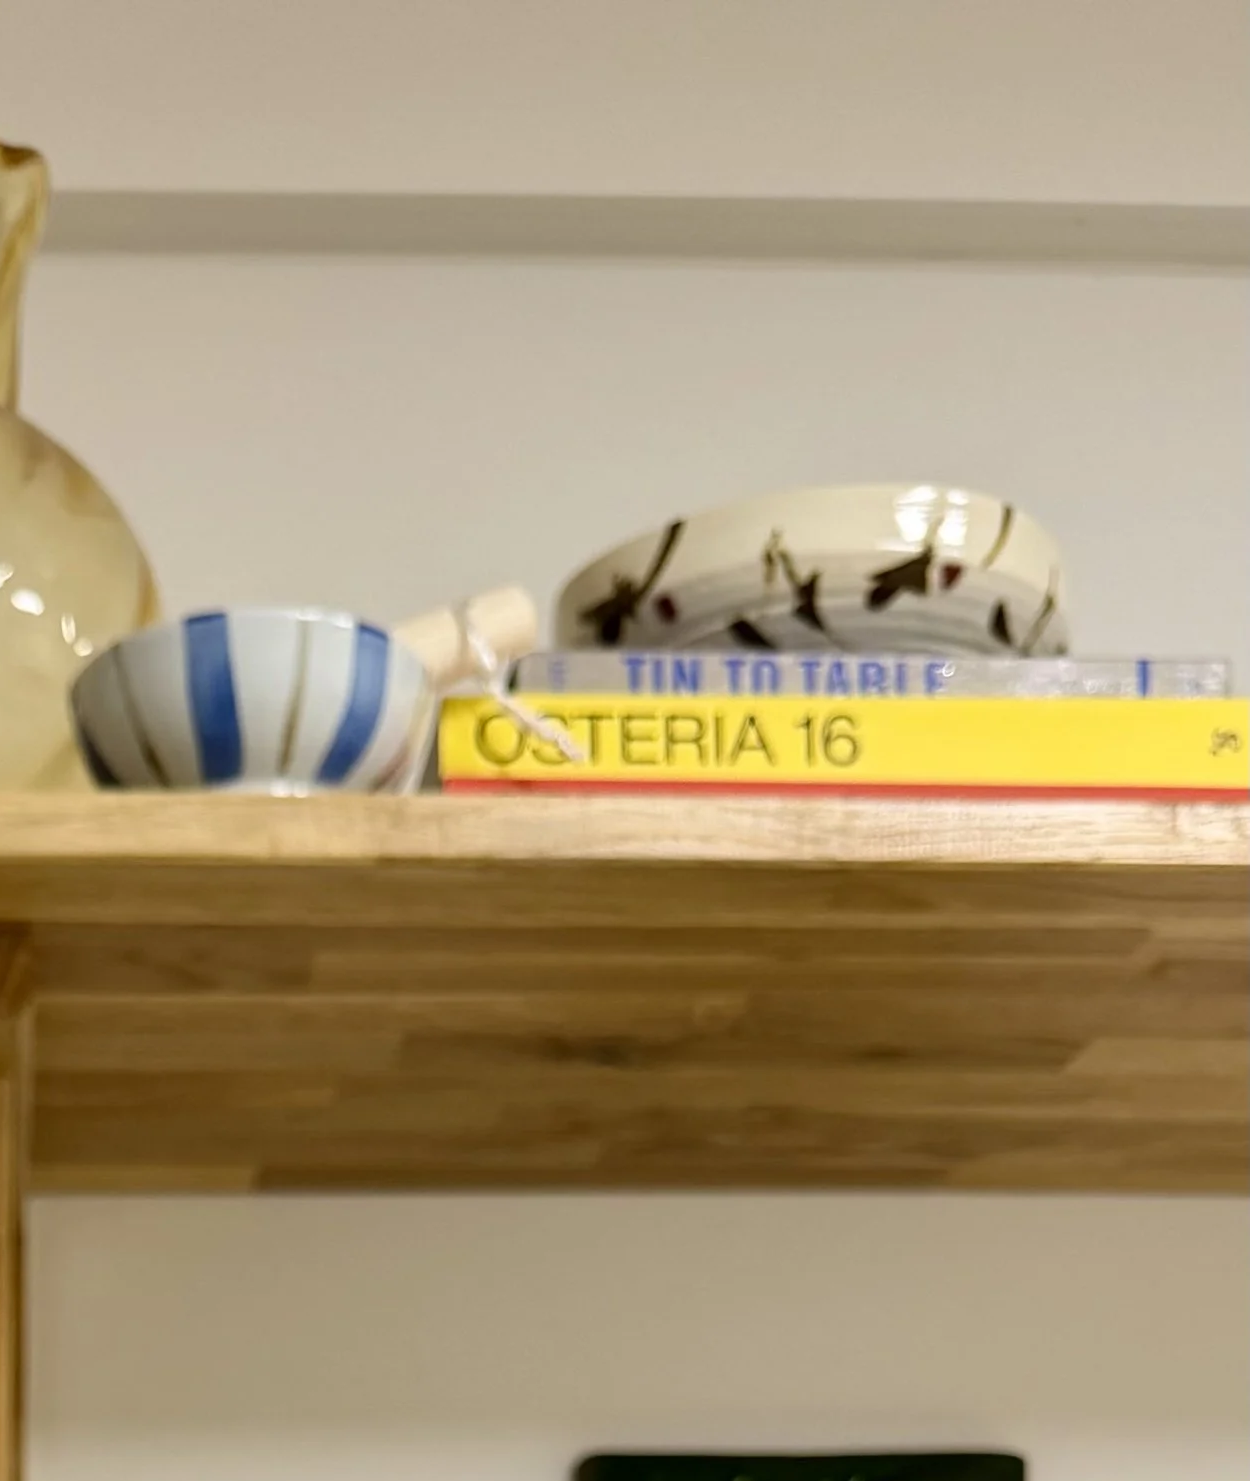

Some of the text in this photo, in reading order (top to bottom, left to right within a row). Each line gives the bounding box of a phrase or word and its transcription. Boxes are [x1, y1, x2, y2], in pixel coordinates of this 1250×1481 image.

[624, 656, 703, 694] TIN
[726, 657, 781, 694] TO
[476, 712, 862, 768] OSTERIA 16
